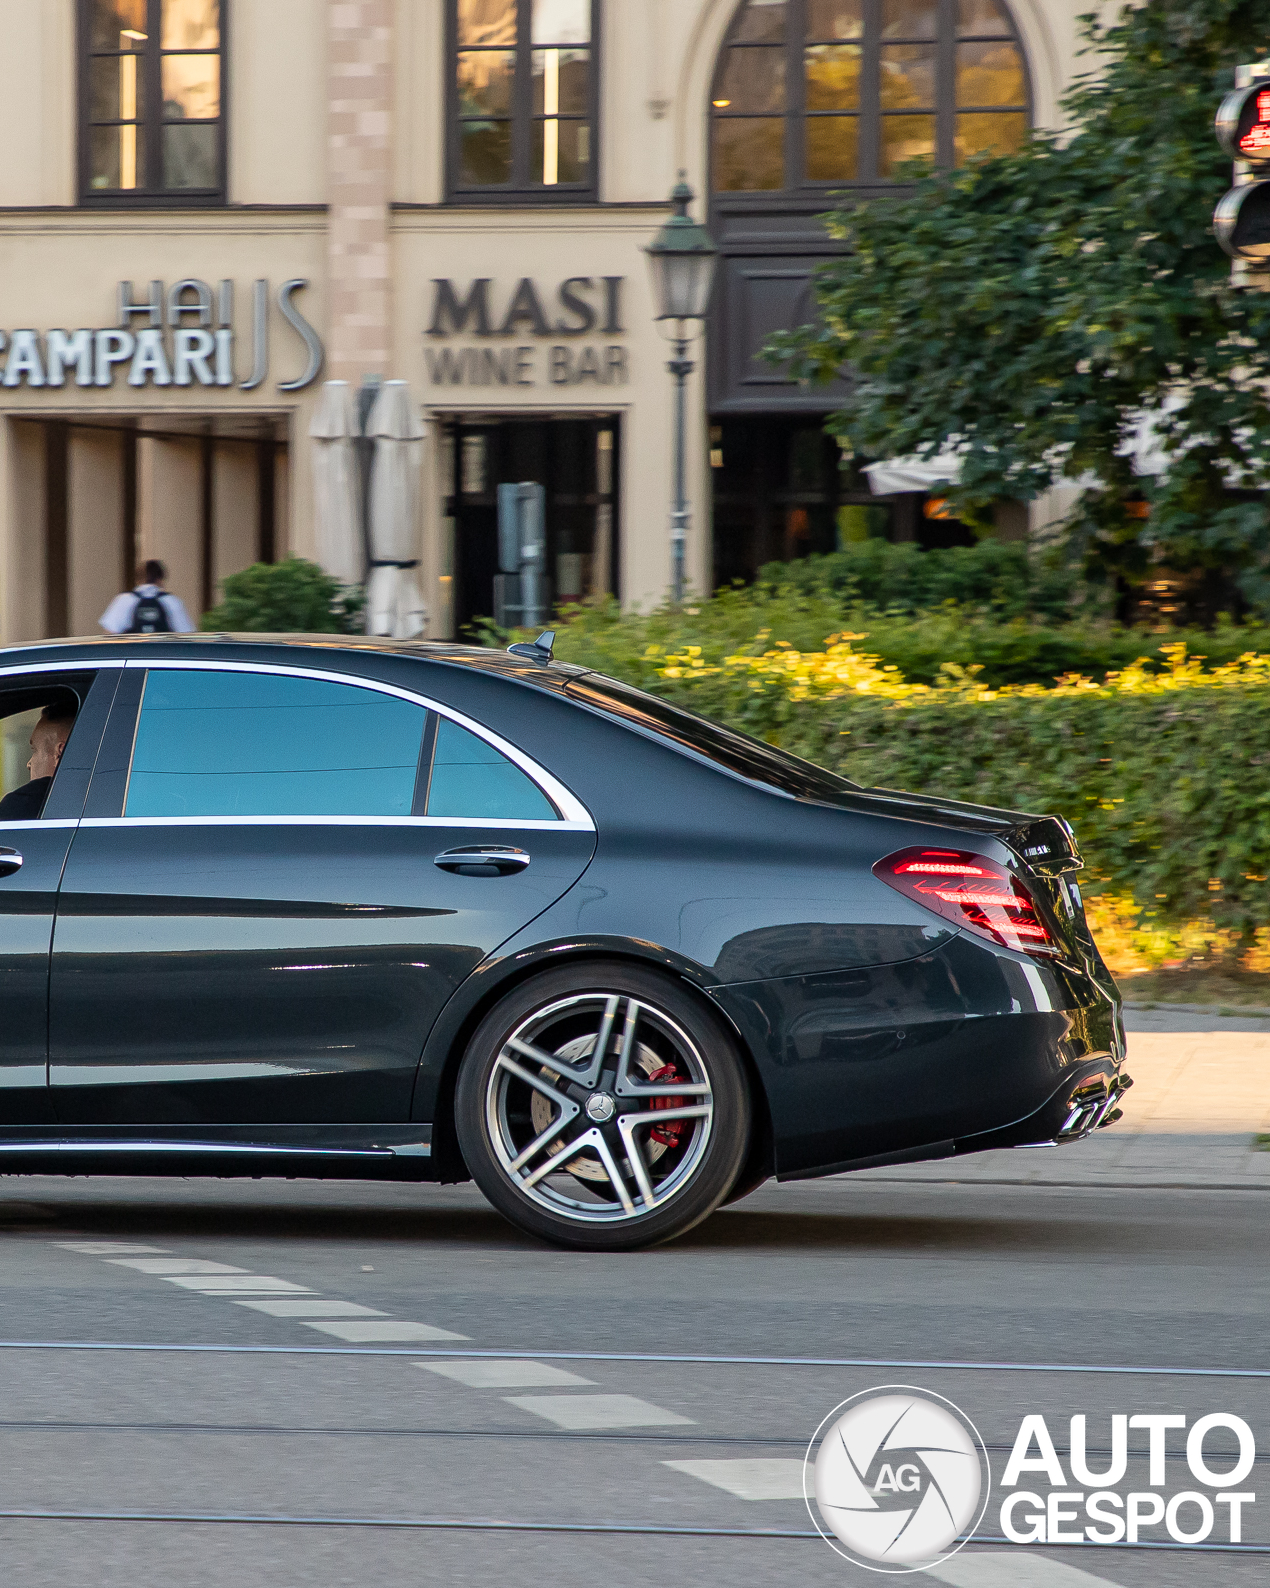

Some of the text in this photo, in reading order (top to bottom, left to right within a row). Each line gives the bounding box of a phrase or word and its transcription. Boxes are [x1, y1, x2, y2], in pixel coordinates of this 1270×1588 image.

[422, 276, 627, 336] MASI
[424, 345, 629, 385] WINE BAR
